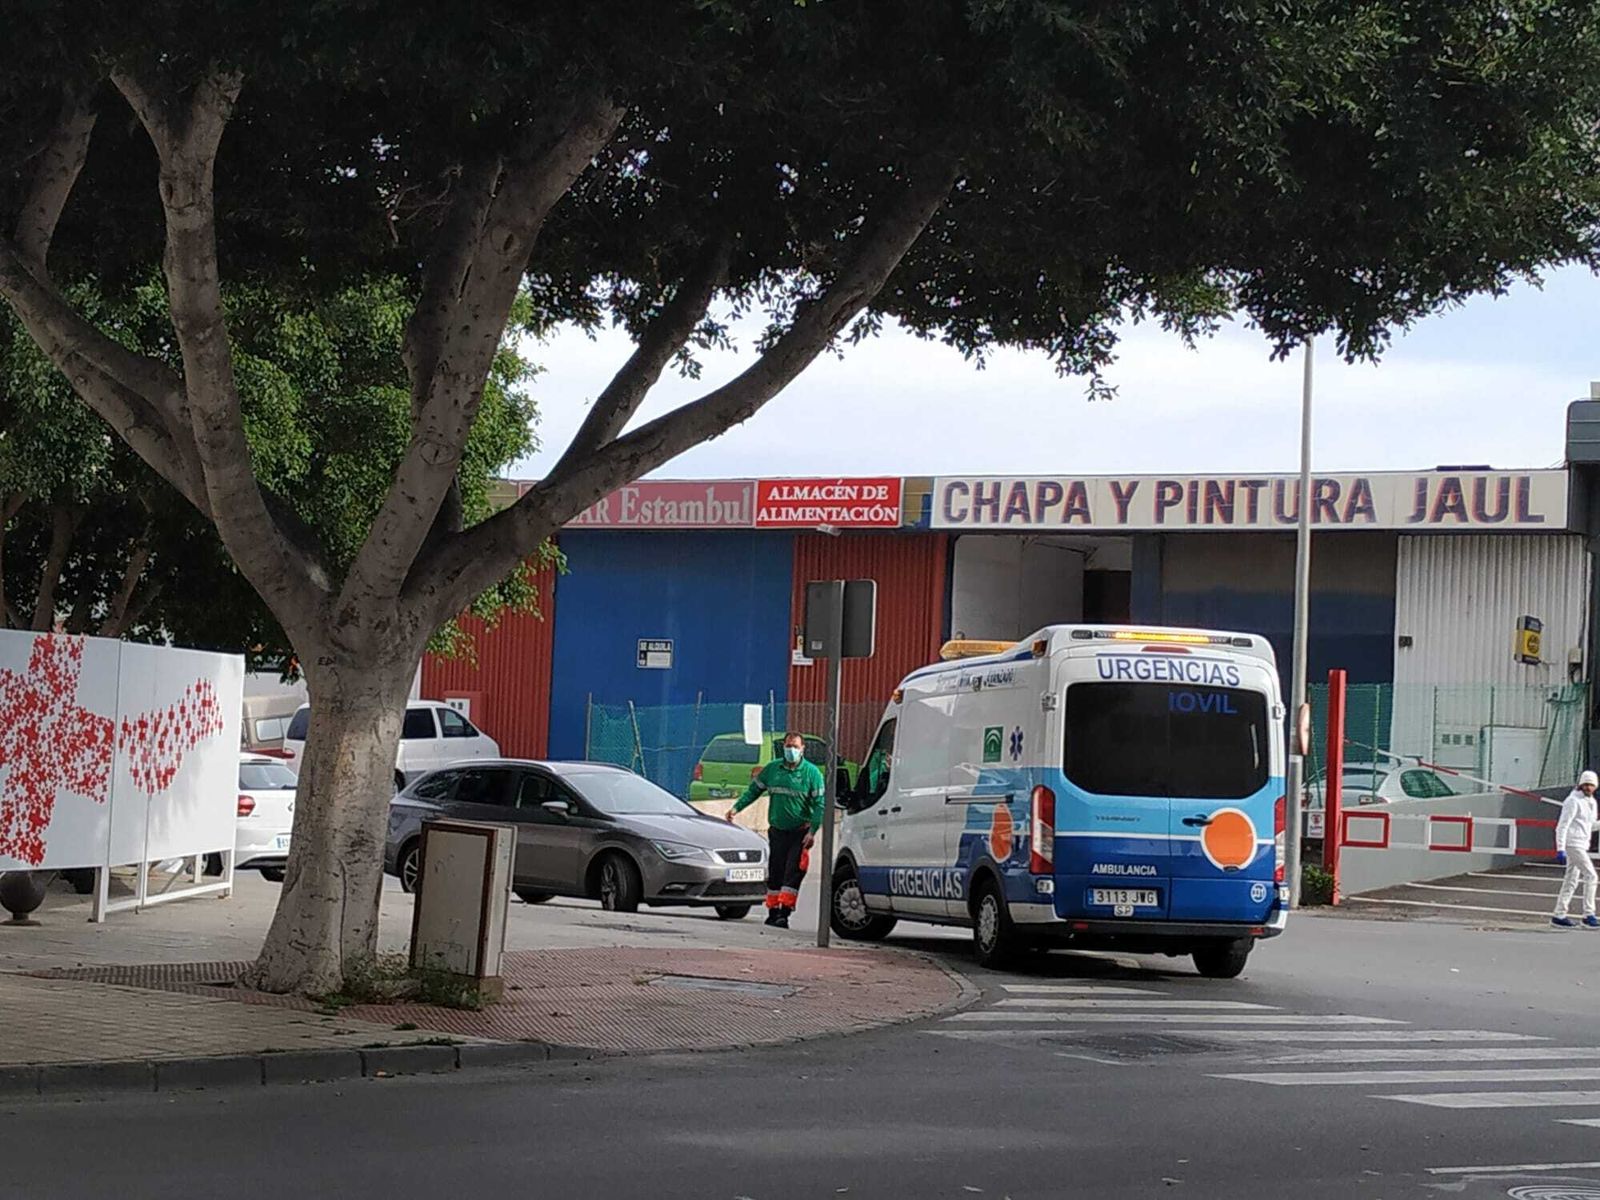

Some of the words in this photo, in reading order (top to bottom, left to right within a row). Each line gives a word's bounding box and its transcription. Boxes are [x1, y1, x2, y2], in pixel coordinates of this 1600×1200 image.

[767, 479, 859, 501] ALMACÉN
[863, 485, 888, 500] DE
[943, 480, 1092, 524] CHAPA
[1109, 480, 1140, 524] Y
[1153, 478, 1377, 524] PINTURA
[1406, 476, 1545, 523] JAUL
[618, 487, 751, 524] Estambul
[757, 504, 898, 522] ALIMENTACIÓN
[1097, 658, 1240, 687] URGENCIAS
[1092, 863, 1157, 876] AMBULANCIA
[889, 868, 963, 898] URGENCIAS
[1097, 890, 1128, 904] 3113
[1132, 891, 1154, 904] JWG
